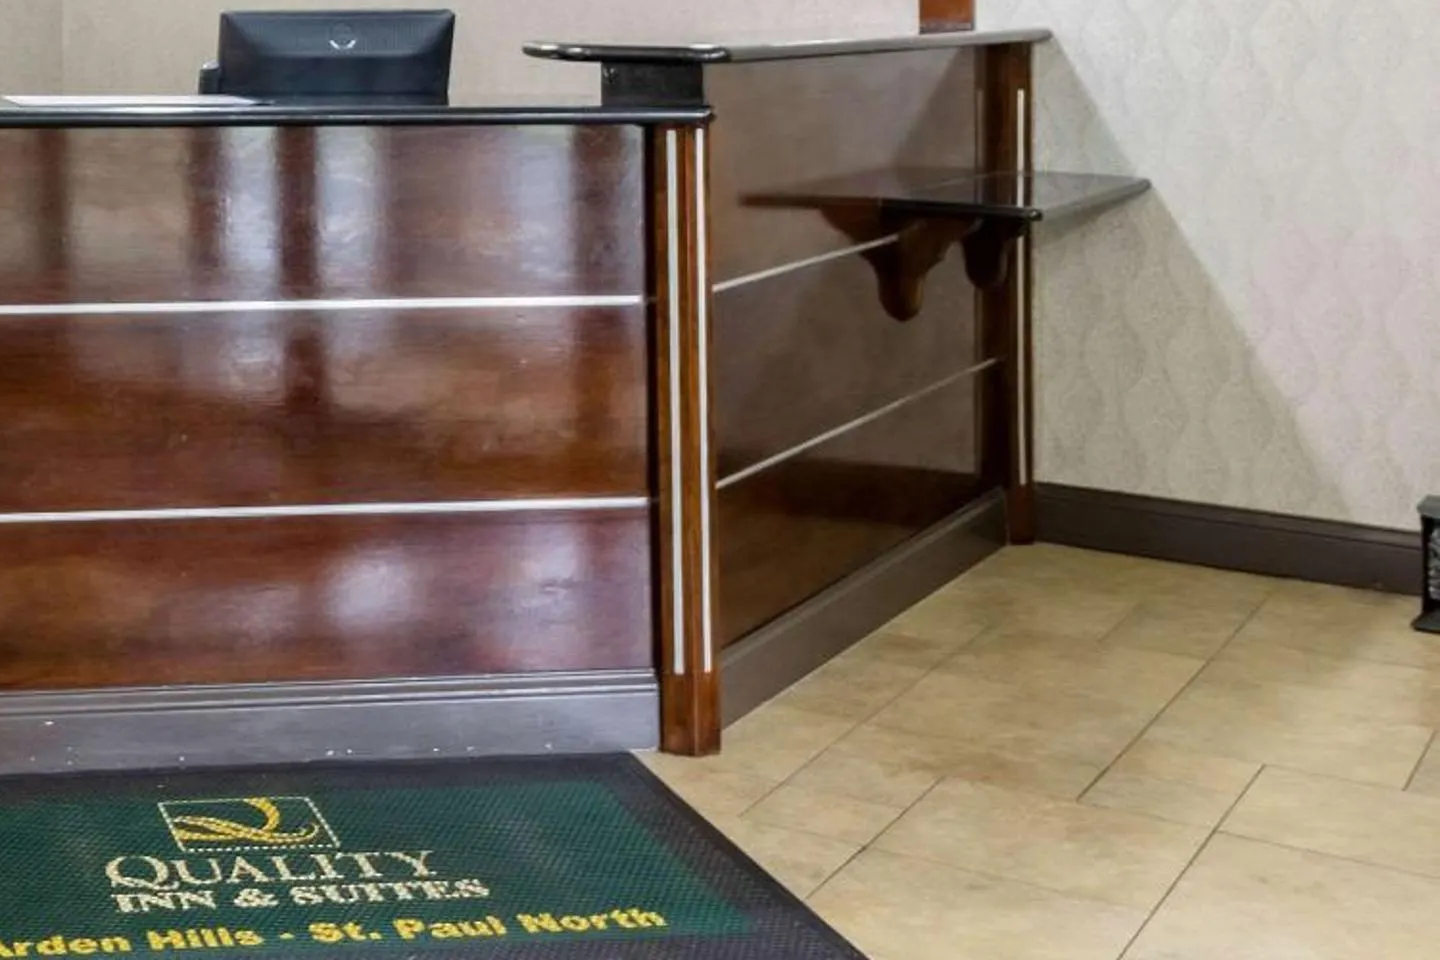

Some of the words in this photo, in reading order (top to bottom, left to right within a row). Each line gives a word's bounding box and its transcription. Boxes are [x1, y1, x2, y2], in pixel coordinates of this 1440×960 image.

[105, 850, 437, 890] QUALITY
[111, 890, 217, 913] INN
[233, 888, 279, 907] &
[289, 878, 490, 905] SUITES
[147, 926, 264, 950] Hills
[309, 921, 382, 943] St.
[393, 916, 507, 939] Paul
[517, 908, 667, 933] North
